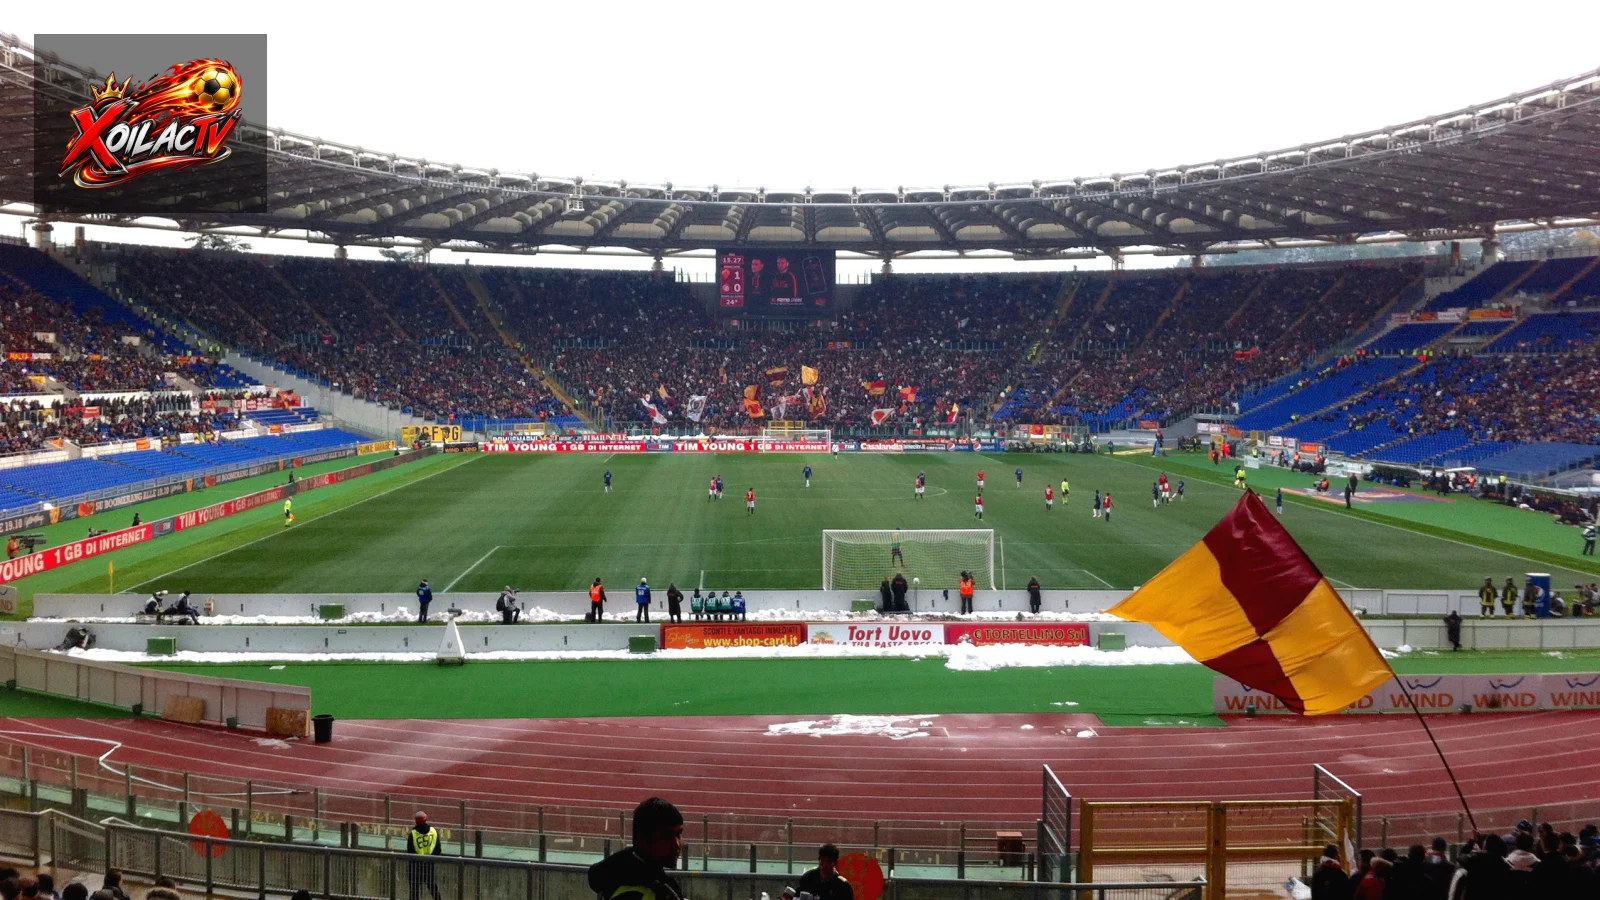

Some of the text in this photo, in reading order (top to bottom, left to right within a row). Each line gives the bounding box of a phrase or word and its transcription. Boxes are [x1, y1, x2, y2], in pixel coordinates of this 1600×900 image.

[734, 271, 741, 280] 1
[734, 283, 741, 292] 0
[486, 443, 509, 451] TIM
[512, 443, 557, 451] YOUNG
[569, 443, 585, 451] GB
[675, 442, 698, 451] TIM
[701, 442, 745, 451] YOUNG
[860, 442, 903, 450] Casalandia
[104, 492, 143, 508] BOOMERANG
[179, 511, 197, 529] TIM
[198, 504, 225, 523] YOUNG
[230, 503, 235, 513] 1
[235, 498, 247, 511] GB
[4, 518, 23, 532] 19.10
[54, 549, 61, 564] 1
[64, 543, 83, 561] GB
[85, 541, 97, 555] DI
[99, 527, 147, 552] INTERNET
[703, 627, 726, 635] SCONTI
[765, 626, 798, 634] IMMEDIATI
[848, 626, 932, 641] Tort Uovo
[984, 629, 1064, 640] TORTELLINO
[703, 635, 798, 646] www.shop-card.it
[1390, 693, 1454, 708] WIND
[1473, 693, 1537, 708] WIND
[1551, 691, 1600, 706] WIN
